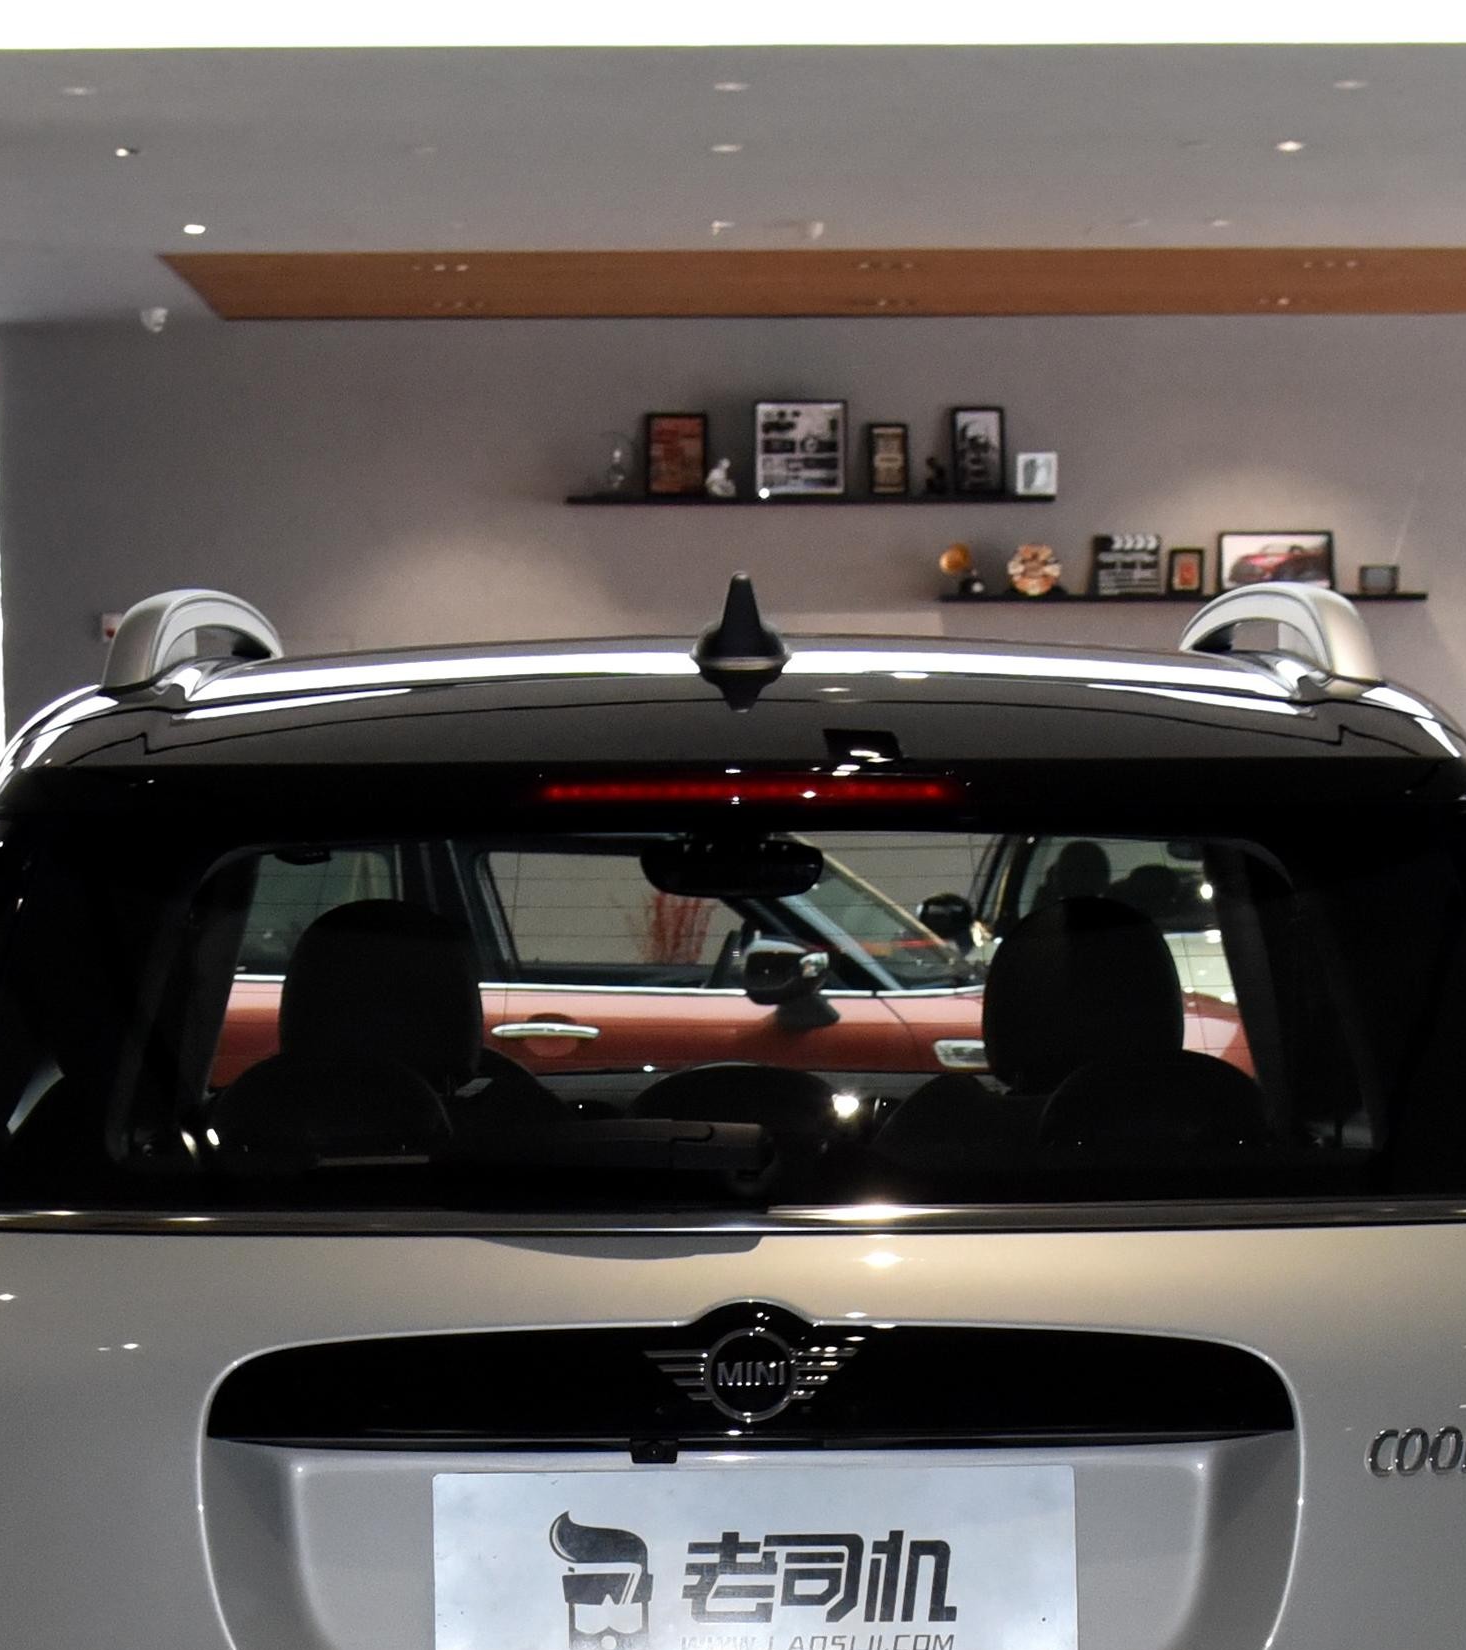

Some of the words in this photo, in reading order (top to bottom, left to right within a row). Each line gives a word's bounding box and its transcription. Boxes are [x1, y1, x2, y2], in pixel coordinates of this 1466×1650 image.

[717, 1361, 786, 1387] MINI
[682, 1530, 957, 1624] 老司机
